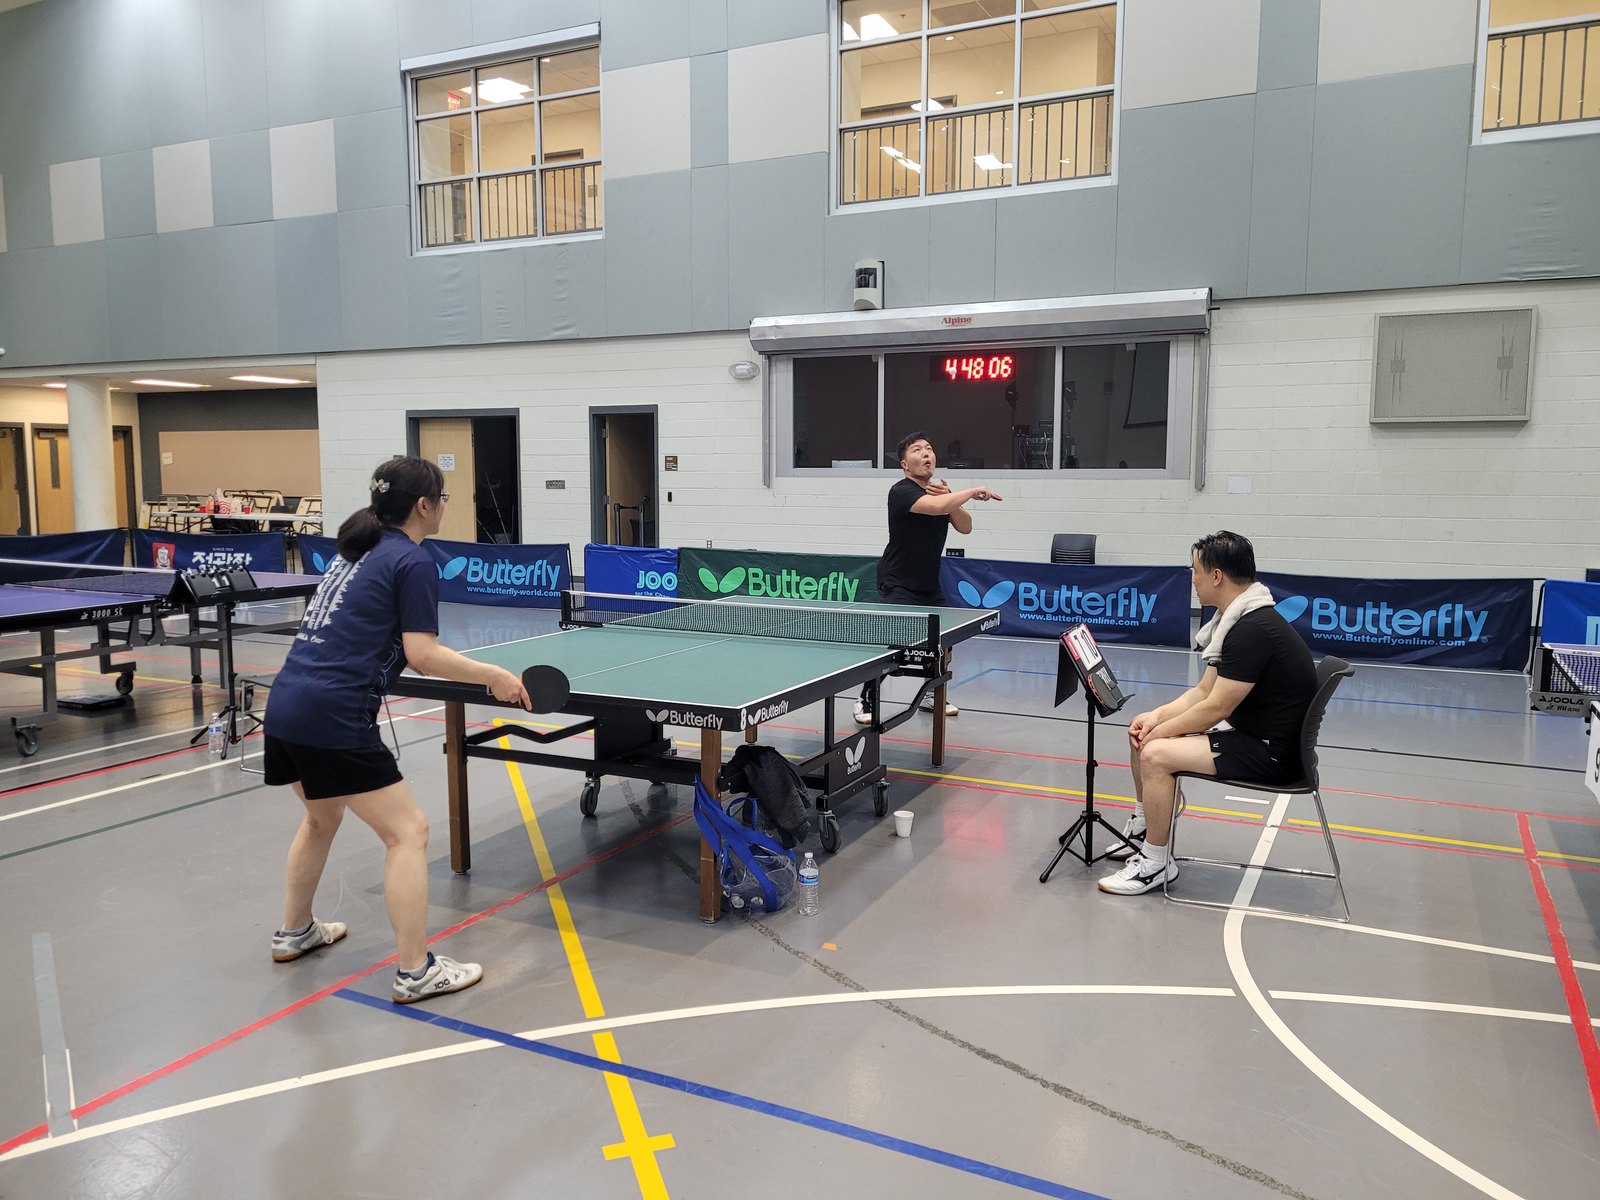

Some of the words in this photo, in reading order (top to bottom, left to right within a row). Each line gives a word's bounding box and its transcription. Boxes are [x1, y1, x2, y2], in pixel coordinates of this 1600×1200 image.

[941, 316, 972, 325] Alpine
[961, 357, 985, 379] 48
[988, 356, 1013, 378] 06
[466, 556, 561, 590] Butterfly
[466, 585, 561, 597] www.butterfly-world.com
[748, 567, 860, 602] Butterfly
[1018, 581, 1158, 623] Butterfly
[91, 608, 111, 619] 3000
[1019, 612, 1140, 627] www.Butterflyonline.com
[1311, 597, 1489, 642] Butterfly
[1312, 631, 1466, 647] www.Butterflyonline.com
[910, 649, 935, 657] JOOLA
[1548, 696, 1585, 706] JOOLA
[669, 710, 724, 731] Butterfly
[740, 708, 747, 731] 8
[760, 700, 789, 722] Butterfly
